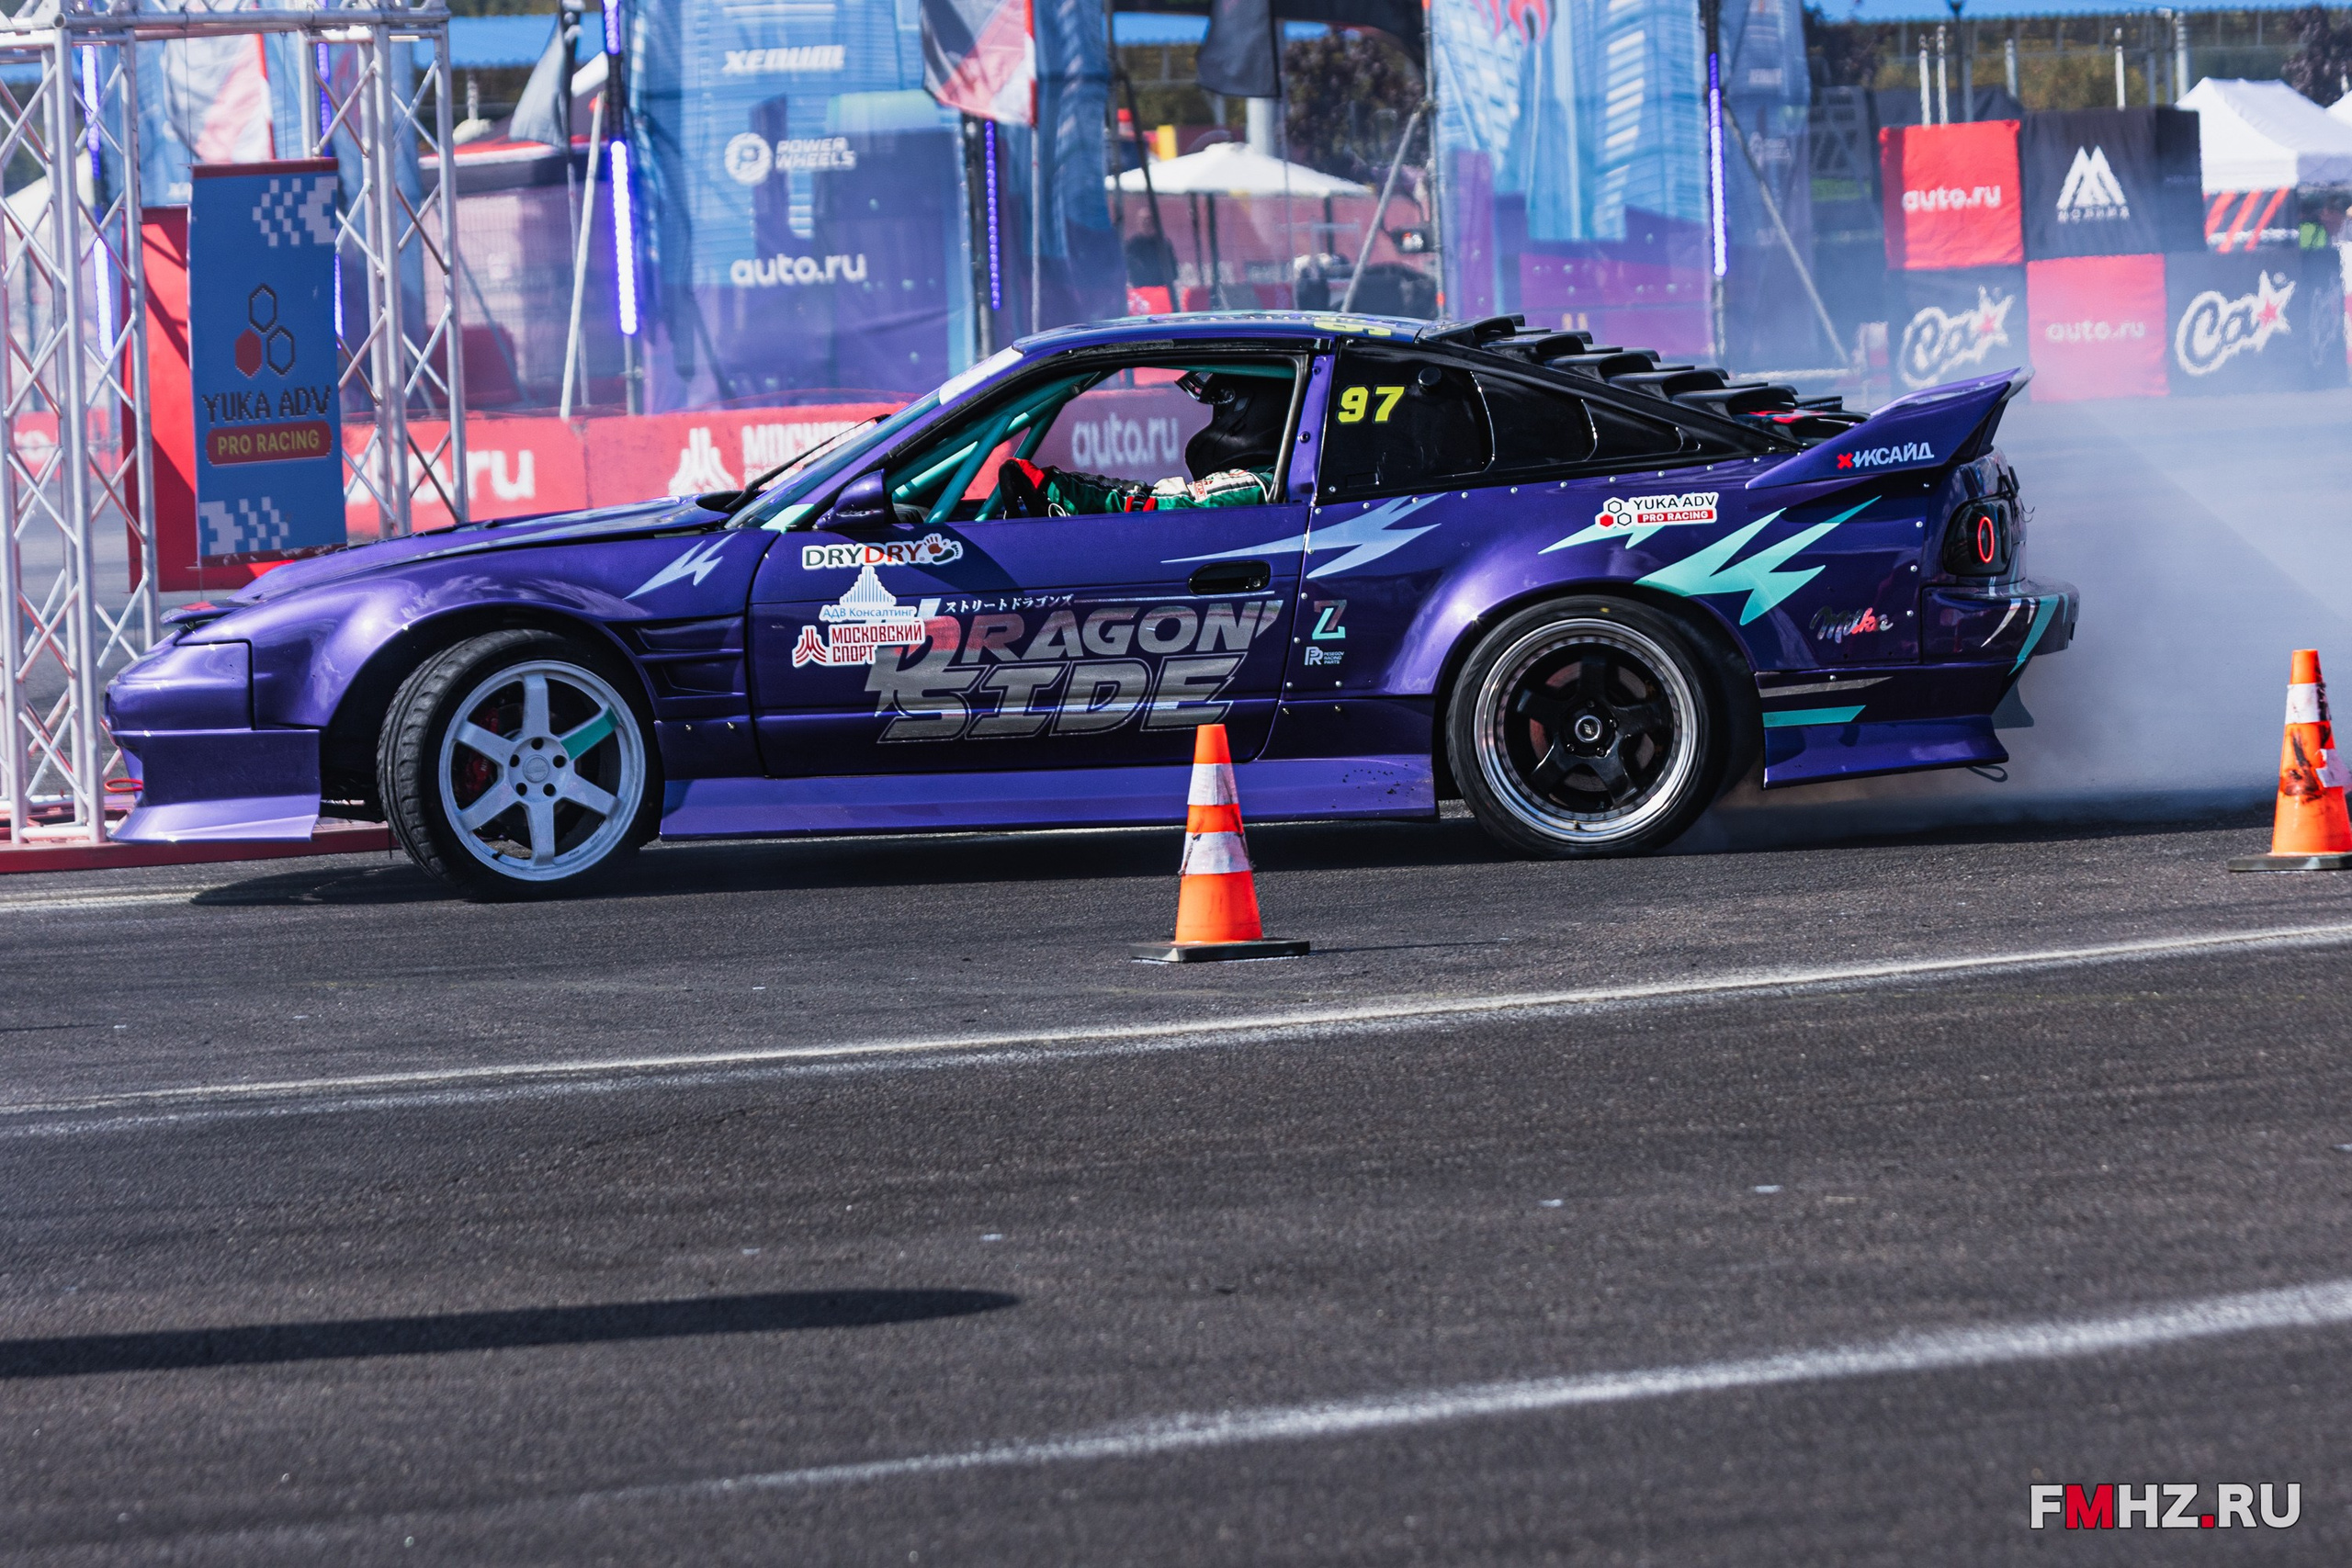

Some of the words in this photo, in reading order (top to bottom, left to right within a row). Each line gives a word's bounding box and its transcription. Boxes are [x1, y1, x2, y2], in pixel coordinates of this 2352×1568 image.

[776, 138, 848, 154] POWER
[775, 152, 856, 171] WHEELS
[1902, 185, 2001, 211] auto.ru
[730, 253, 866, 287] auto.ru
[2045, 320, 2145, 343] auto.ru
[201, 388, 272, 423] YUKA
[278, 384, 332, 419] ADV
[1337, 386, 1406, 423] 97
[217, 434, 252, 457] PRO
[257, 429, 320, 452] RACING
[1071, 412, 1179, 469] auto.ru
[1634, 497, 1679, 511] YUKA
[1682, 494, 1715, 508] ADV
[1642, 513, 1665, 523] PRO
[1668, 510, 1709, 521] RACING
[822, 607, 846, 617] АДВ
[849, 607, 914, 617] Консалтинг
[831, 621, 922, 644] МОСКОВСКИЙ
[832, 645, 874, 662] СПОРТ
[876, 651, 1248, 743] SIDE
